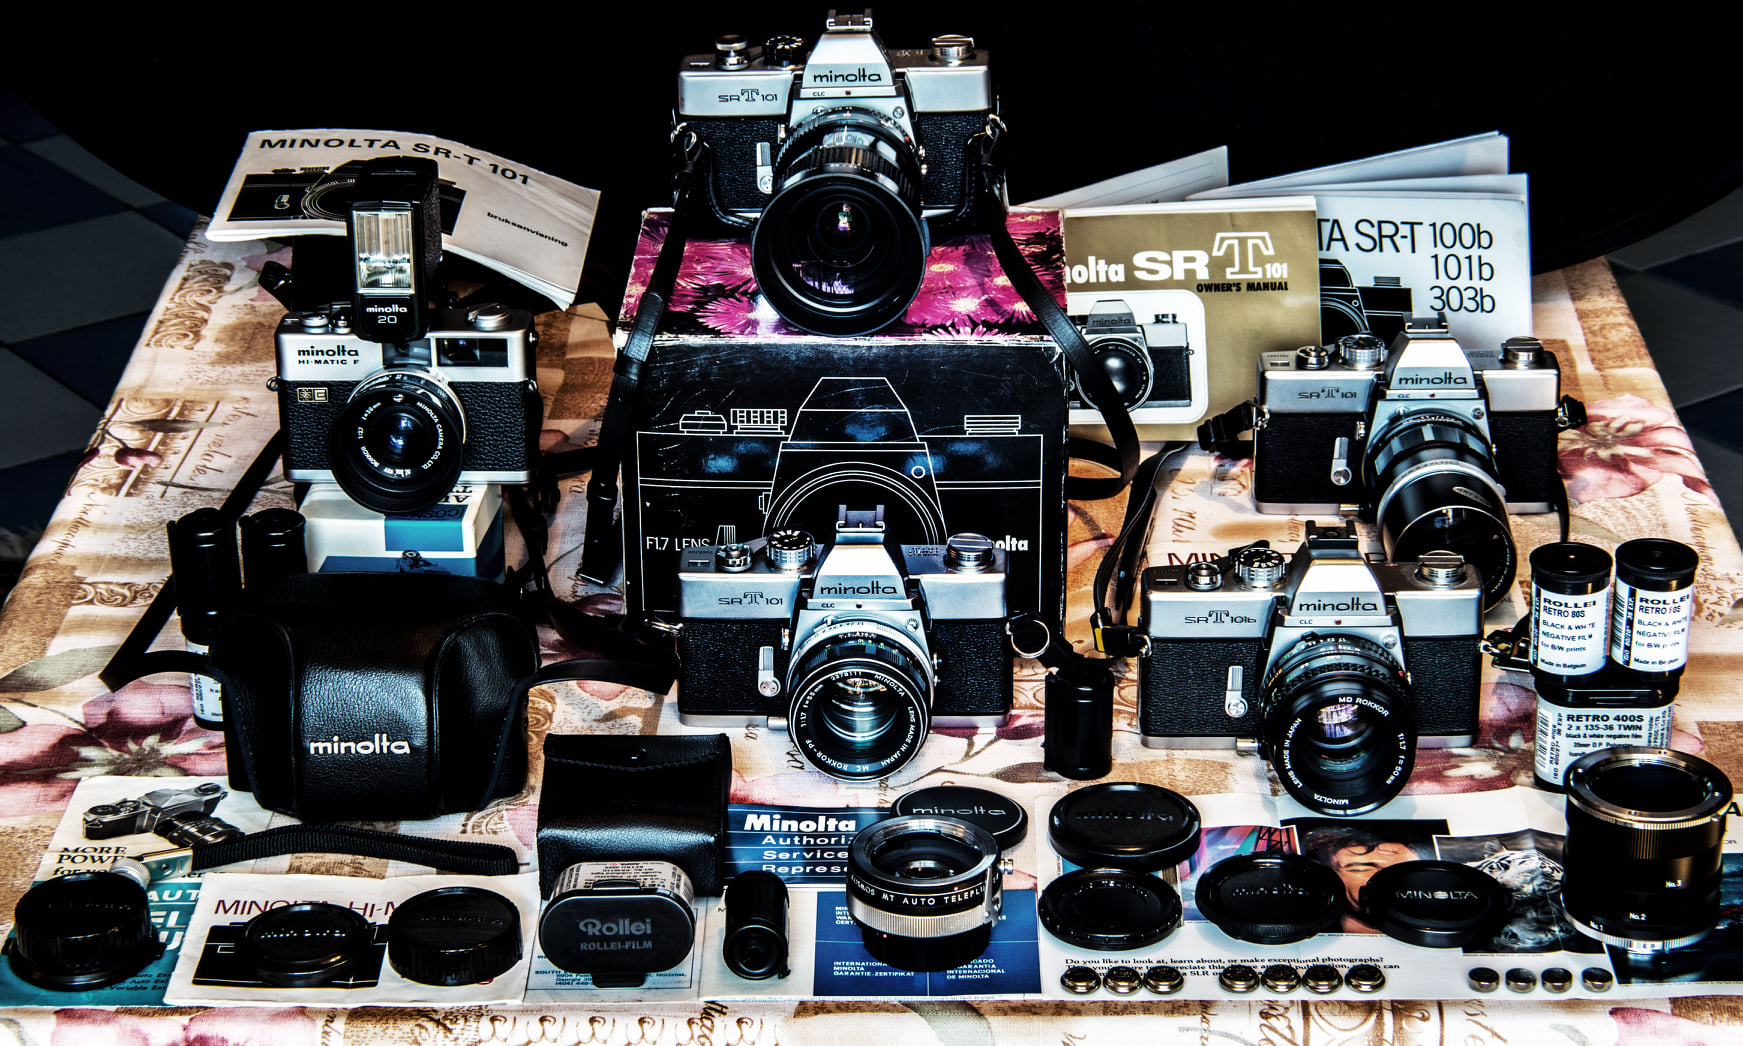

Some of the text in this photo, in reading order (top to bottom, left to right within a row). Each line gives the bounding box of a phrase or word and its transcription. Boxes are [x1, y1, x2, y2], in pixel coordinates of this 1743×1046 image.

[813, 67, 882, 82] minolta
[259, 138, 530, 185] MINOLTA SR-T 101
[1355, 218, 1424, 254] SR-T
[1429, 222, 1493, 250] 100b
[1429, 254, 1494, 282] 101b
[1196, 282, 1288, 293] OWNER'S MANUAL
[1429, 285, 1496, 314] 303b
[366, 304, 408, 313] minolta
[377, 315, 397, 324] 20
[297, 345, 359, 357] minolta
[1399, 371, 1468, 385] minolta
[416, 401, 439, 423] MINOLTA
[646, 536, 669, 551] F1.7
[992, 535, 1029, 551] olta
[820, 581, 897, 595] minolta
[1299, 597, 1379, 612] minolta
[1543, 598, 1597, 608] ROLLEI
[1639, 594, 1690, 605] ROLLEI
[1543, 606, 1569, 617] RETRO
[1638, 605, 1667, 615] RETRO
[1542, 620, 1565, 630] BLACK
[1637, 619, 1662, 627] BLACK
[1541, 631, 1577, 641] NEGATIVE
[874, 674, 905, 698] MINOLTA
[1355, 698, 1390, 717] ROKKOR
[1567, 714, 1644, 722] RETRO 400S
[1287, 718, 1302, 738] JAPAN
[881, 706, 916, 767] LENS MADE IN JAPAN
[309, 734, 411, 757] minolta
[856, 764, 869, 772] MC
[1286, 769, 1303, 788] LENS
[1314, 793, 1349, 806] MINOLTA
[912, 806, 1007, 817] minolta
[744, 814, 856, 833] Minolta
[762, 835, 853, 845] Authori
[762, 850, 849, 860] Service
[1395, 890, 1480, 900] MINOLTA
[902, 897, 936, 906] AUTO
[578, 918, 652, 936] Rollei
[580, 941, 653, 951] ROLLEI-FILM
[1321, 956, 1384, 964] photographs?
